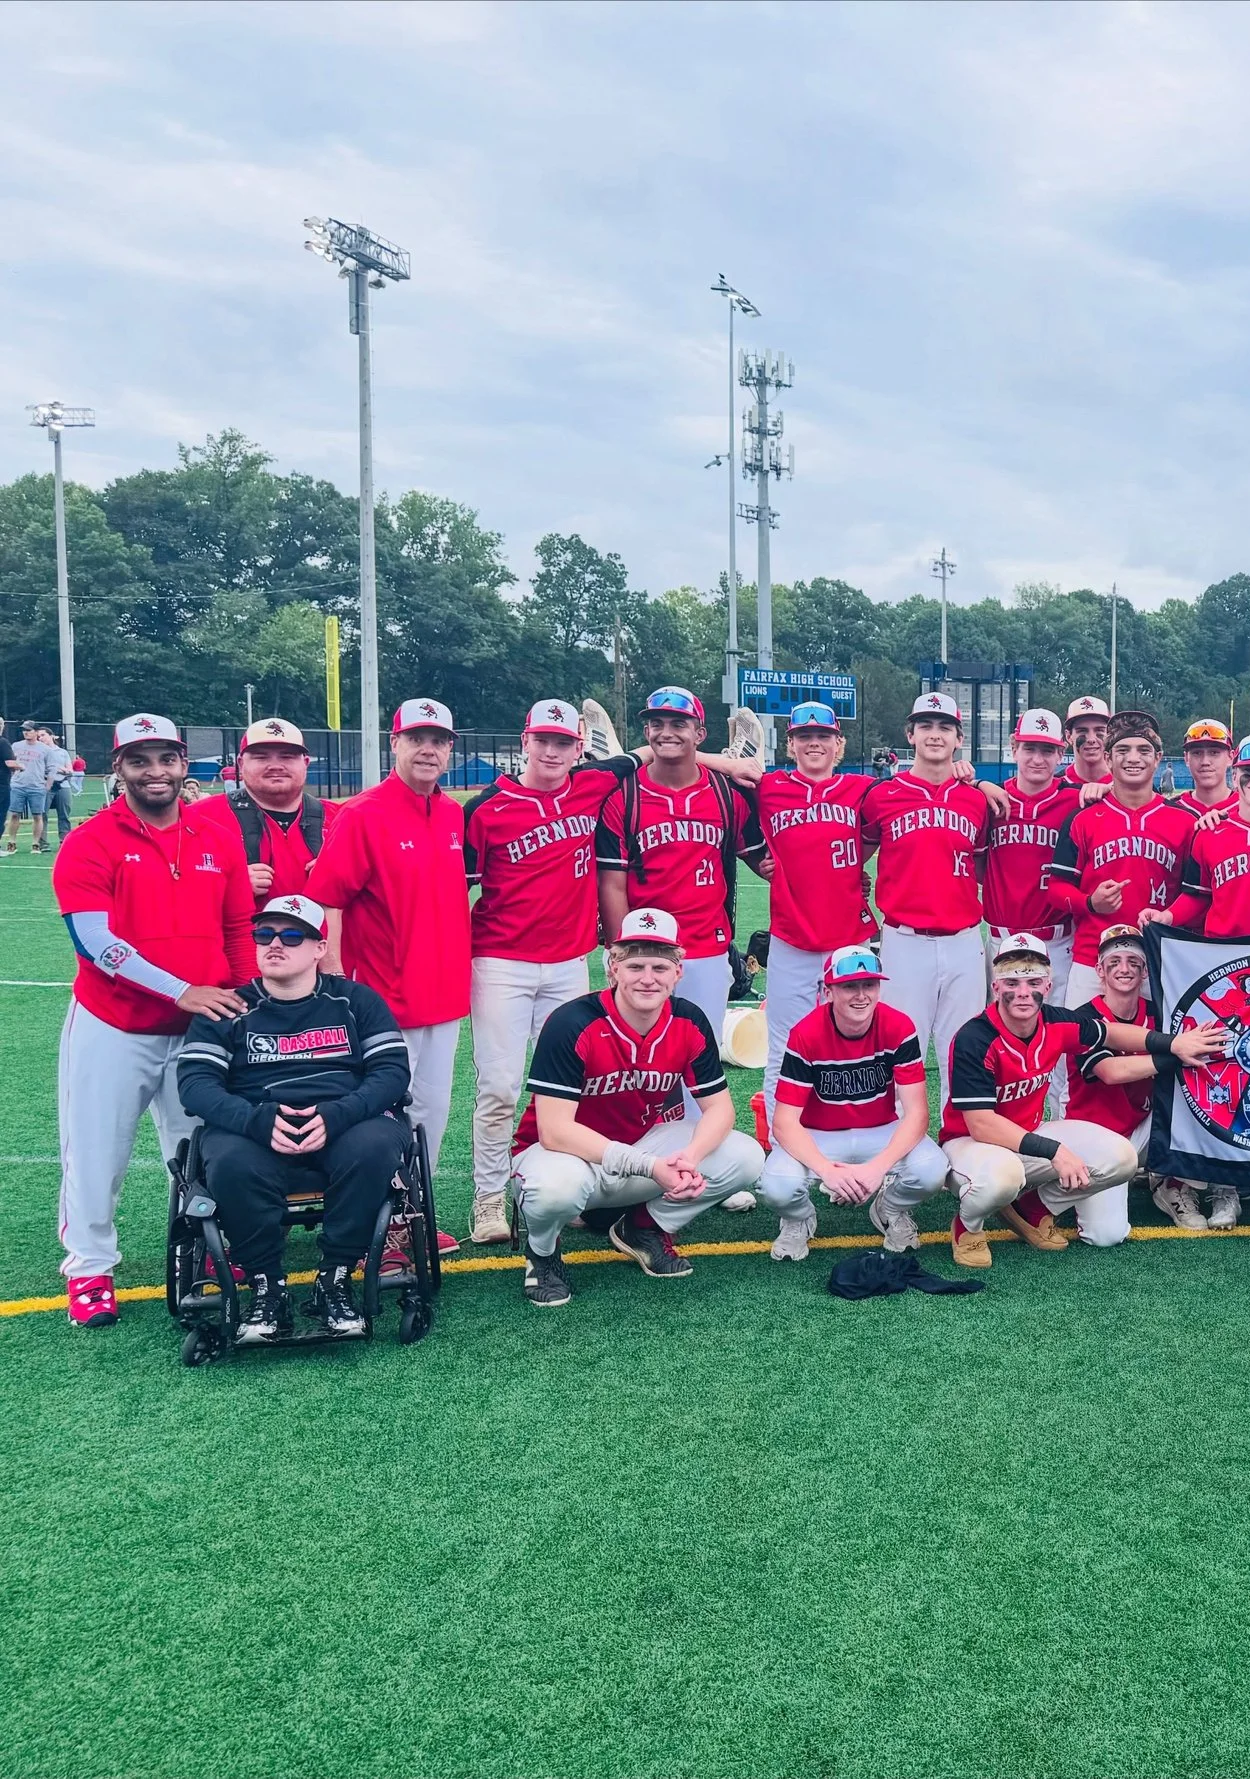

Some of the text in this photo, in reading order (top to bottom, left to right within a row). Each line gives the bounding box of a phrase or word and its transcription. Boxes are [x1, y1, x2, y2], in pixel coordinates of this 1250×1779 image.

[744, 670, 854, 687] FAIRFAX HIGH SCHOOL
[745, 686, 768, 696] LIONS
[831, 691, 853, 700] GUEST
[769, 802, 857, 838] HERNDON
[890, 806, 979, 849] HERNDON
[505, 814, 598, 864] HERNDON
[202, 853, 214, 867] H
[574, 844, 592, 879] 22
[830, 838, 858, 869] 20
[1093, 835, 1177, 873] HERNDON
[695, 859, 716, 887] 21
[1149, 879, 1167, 906] 14
[1208, 959, 1249, 983] HERNDON
[280, 1028, 349, 1054] BASEBALL
[1181, 1084, 1211, 1127] MARSHALL
